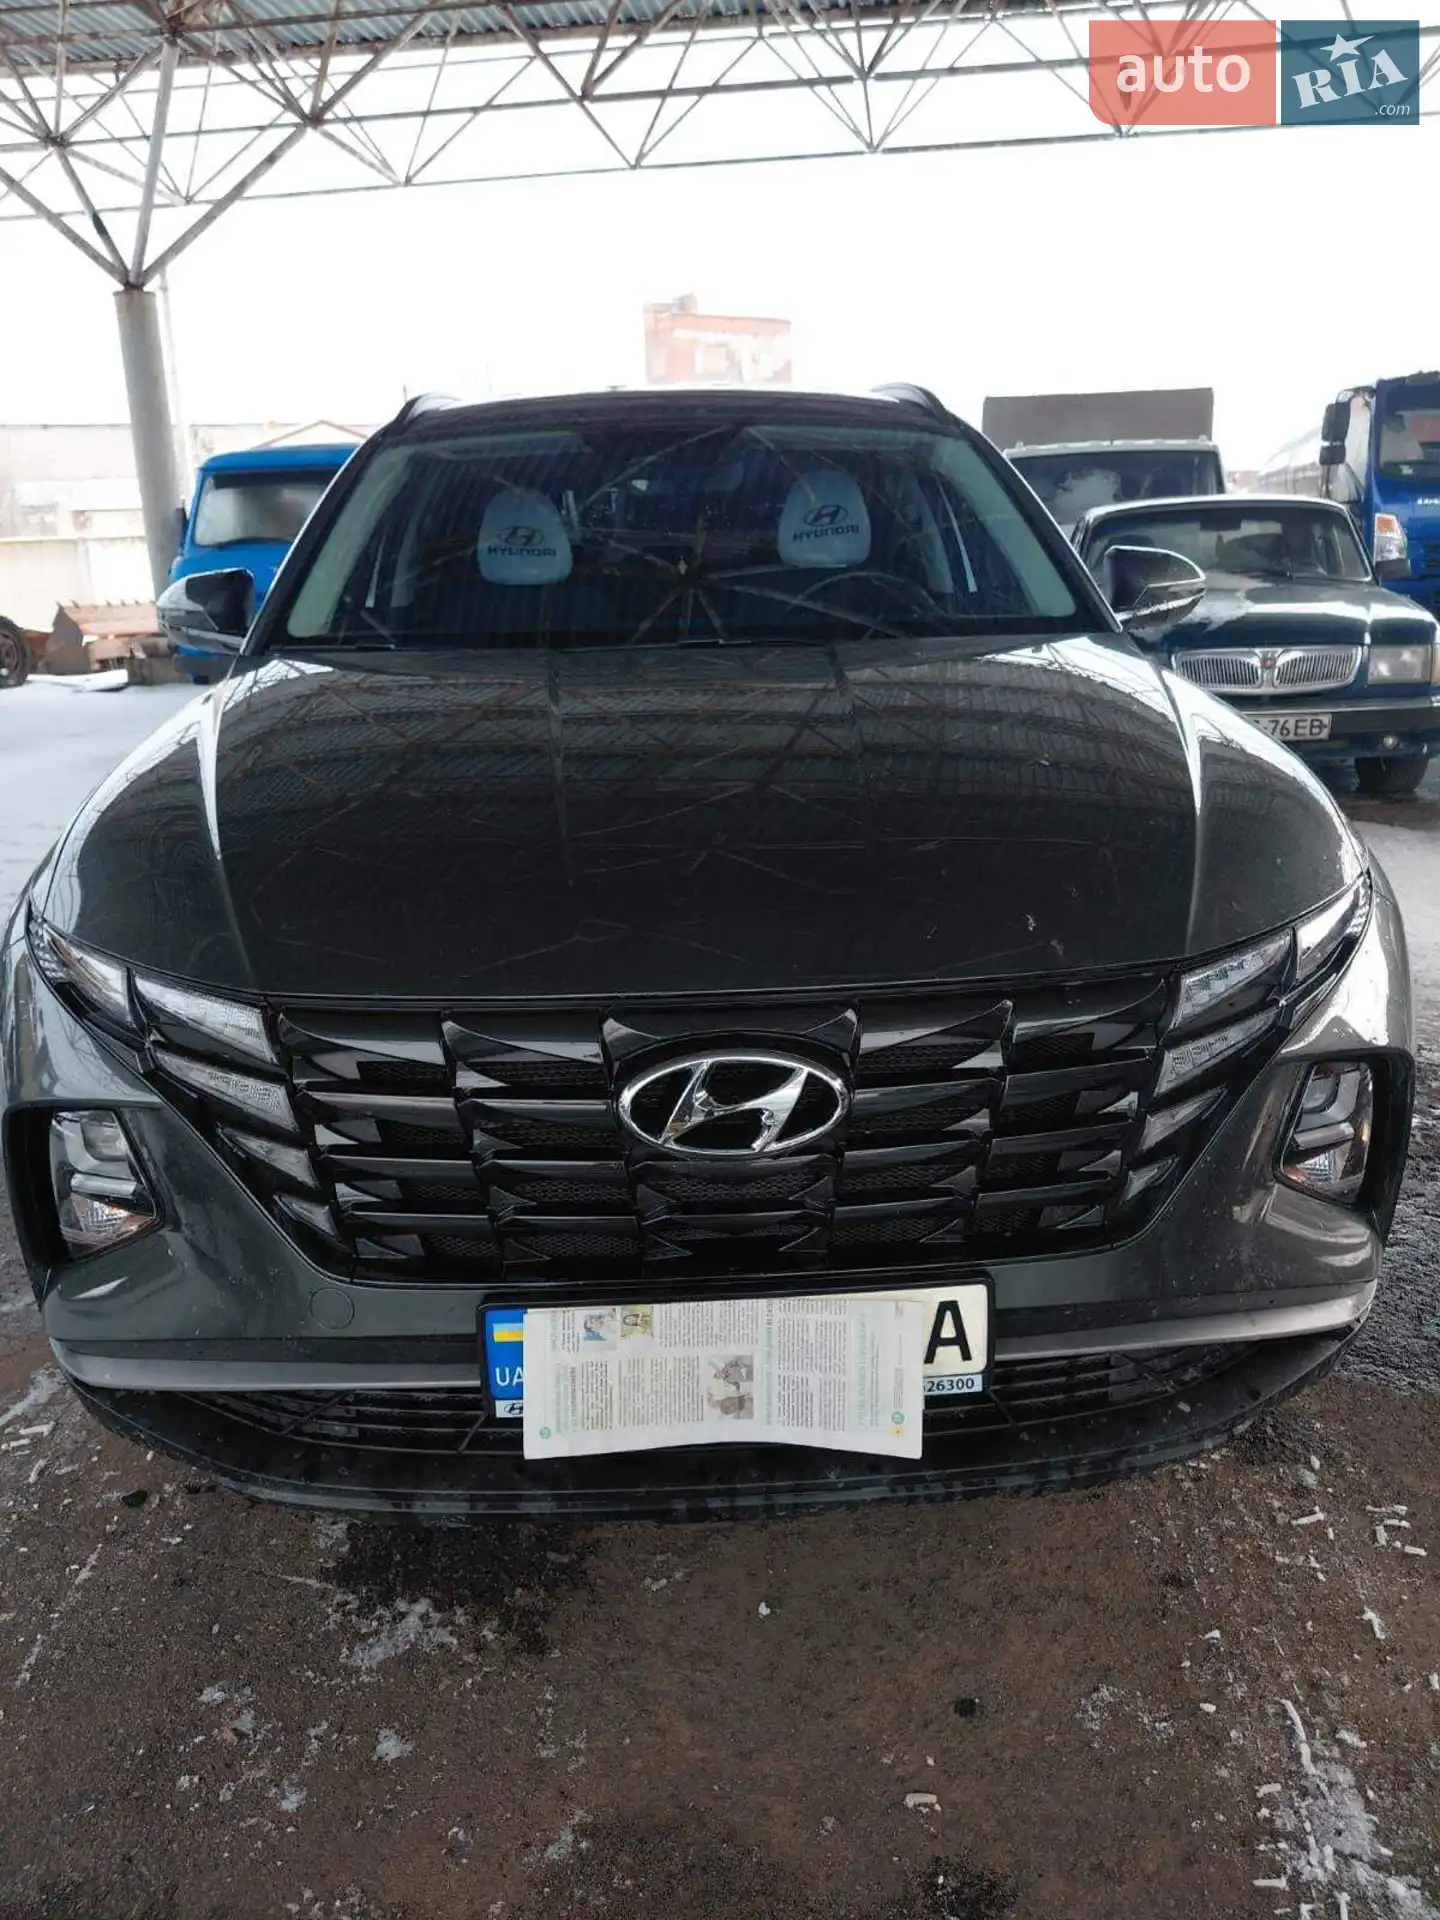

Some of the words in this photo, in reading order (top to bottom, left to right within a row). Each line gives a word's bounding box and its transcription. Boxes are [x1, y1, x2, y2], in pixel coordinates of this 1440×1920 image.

[793, 524, 859, 542] HYUNDAI
[487, 545, 557, 557] HYUNDAI
[923, 1300, 973, 1364] A
[923, 1377, 975, 1393] 26300
